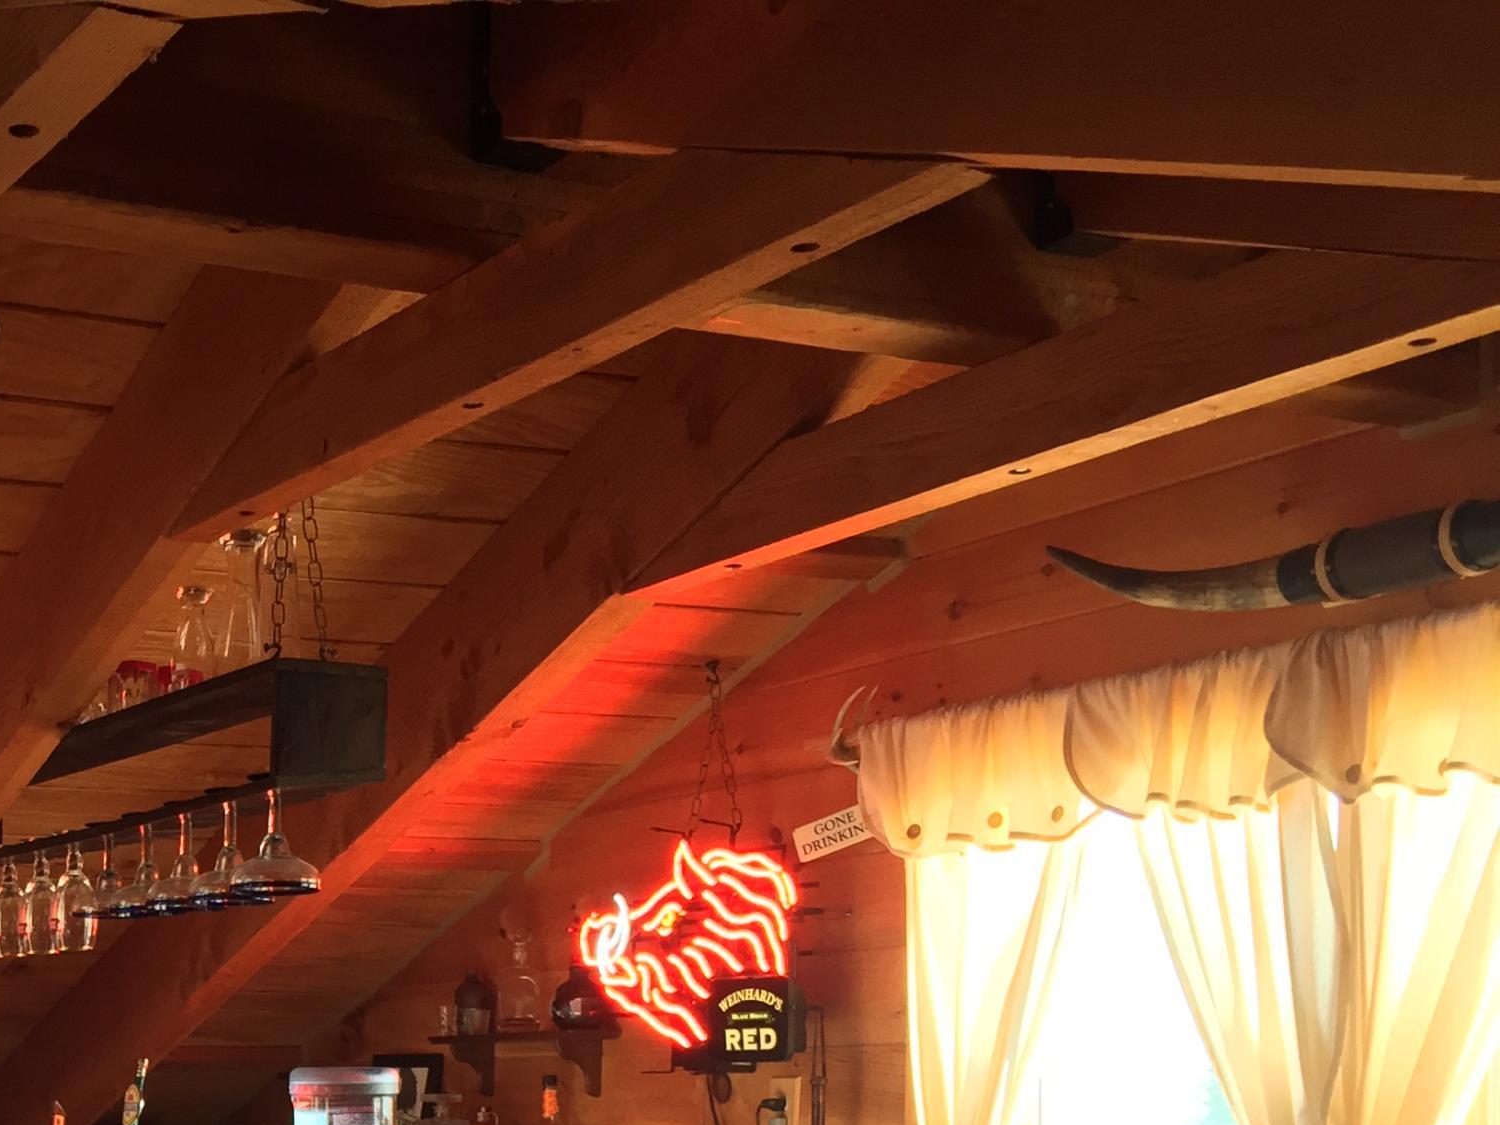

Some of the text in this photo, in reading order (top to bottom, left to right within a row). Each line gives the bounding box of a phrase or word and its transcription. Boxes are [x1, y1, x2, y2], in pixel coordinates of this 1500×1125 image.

[813, 810, 857, 836] GONE
[802, 821, 869, 856] DRINKIN
[717, 987, 784, 1013] WEINHARD'S
[724, 1027, 778, 1051] RED
